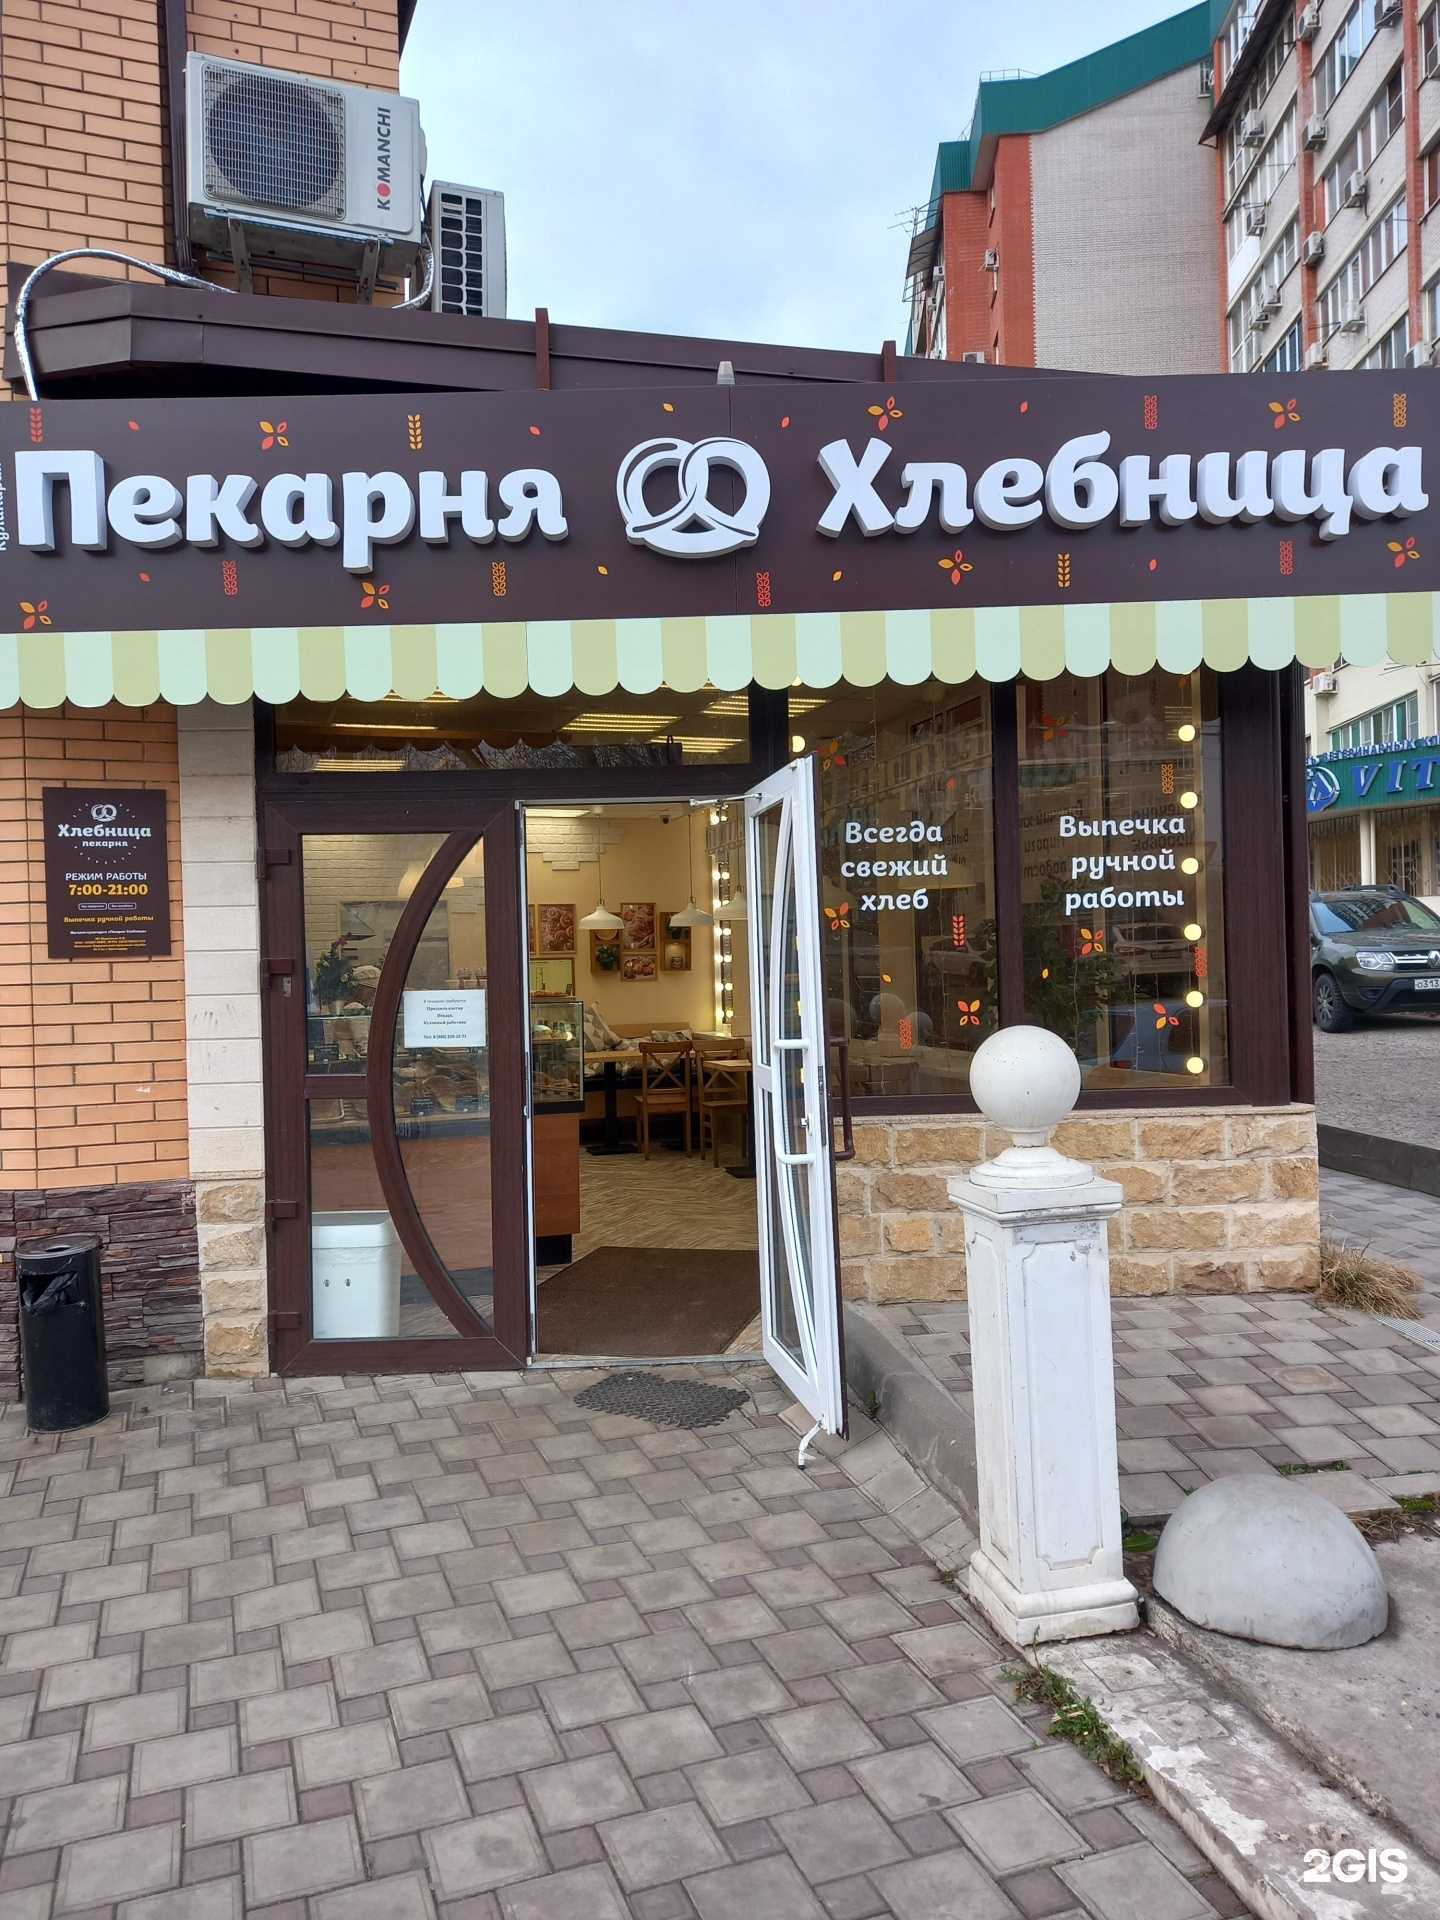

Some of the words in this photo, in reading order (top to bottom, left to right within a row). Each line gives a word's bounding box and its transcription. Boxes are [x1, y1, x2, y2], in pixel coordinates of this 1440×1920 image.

[377, 107, 391, 211] KOMANCHI
[15, 450, 568, 574] Пекарня
[815, 431, 1429, 541] Хлебница
[58, 824, 152, 839] Хлебница
[845, 820, 943, 844] Всегда
[1059, 815, 1186, 838] Выпечка
[65, 873, 103, 881] РЕЖИМ
[106, 872, 147, 880] РАБОТЫ
[841, 854, 948, 878] свежий
[1071, 849, 1176, 880] ручной
[68, 884, 148, 895] 7:00-21:00
[861, 888, 929, 911] хлеб
[1065, 886, 1184, 915] работы
